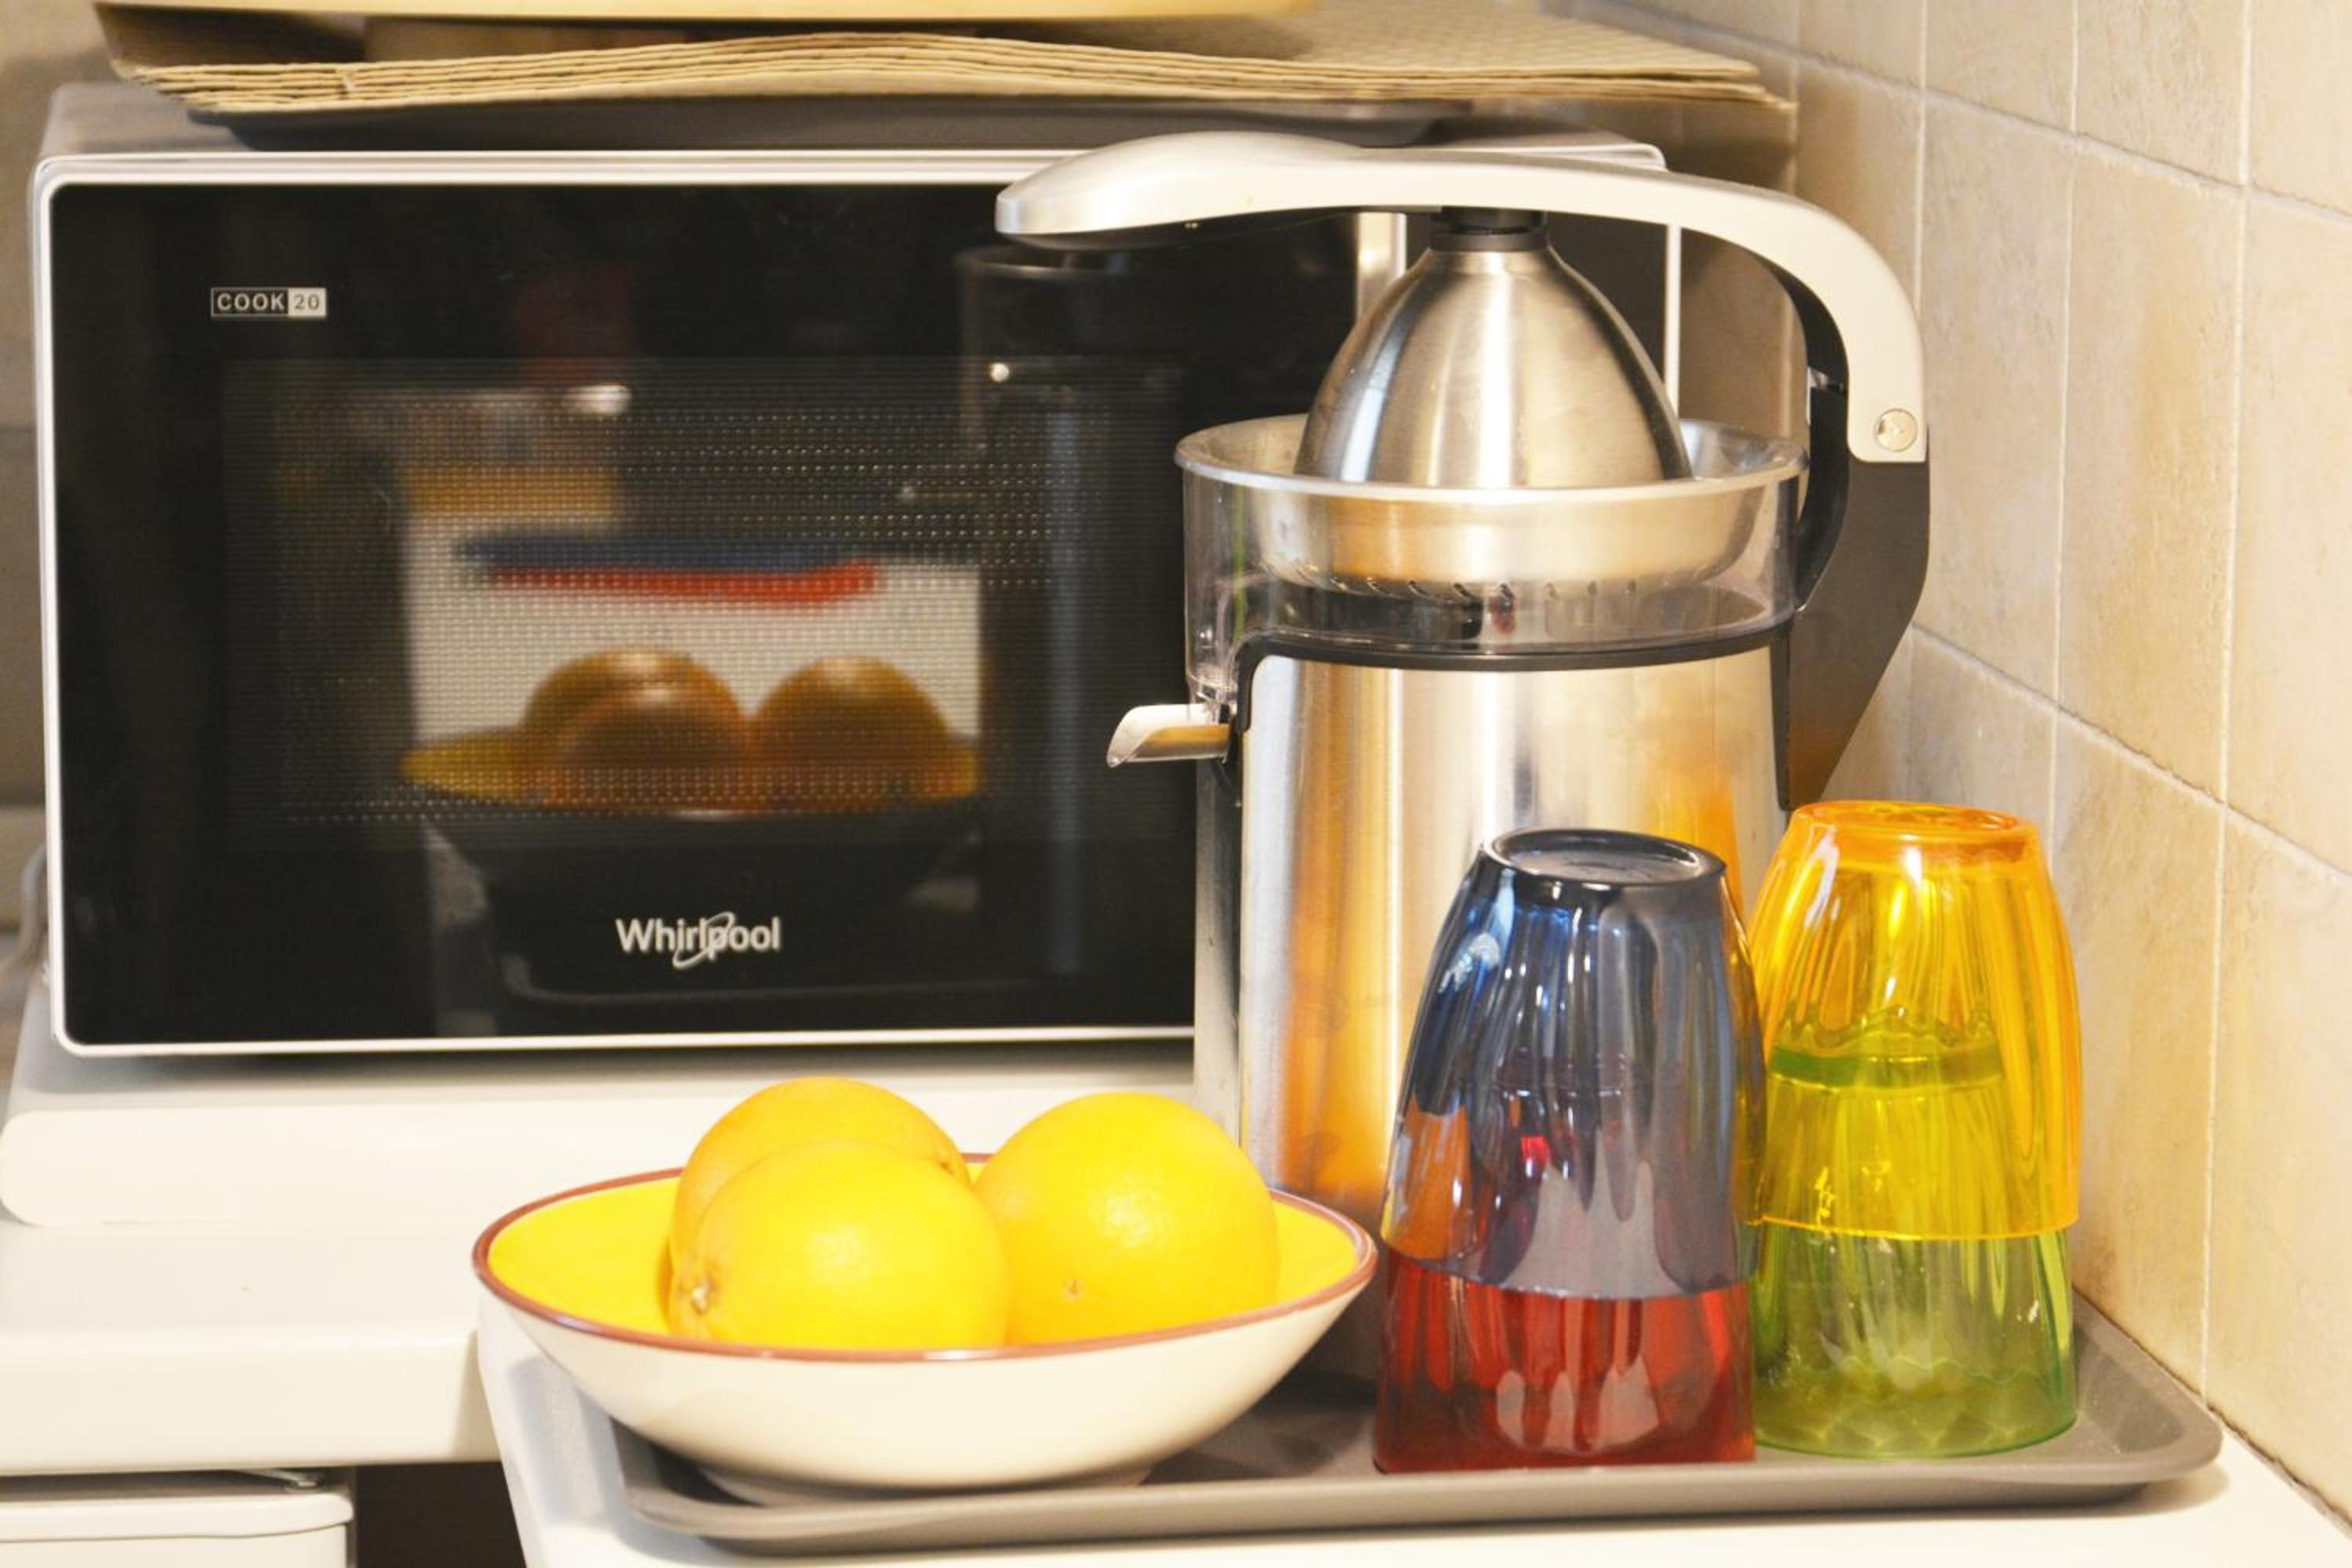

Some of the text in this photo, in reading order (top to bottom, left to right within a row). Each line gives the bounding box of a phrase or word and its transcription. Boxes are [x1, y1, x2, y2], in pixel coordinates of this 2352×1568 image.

[216, 292, 320, 311] COOK 20
[615, 911, 781, 968] Whirlpool
